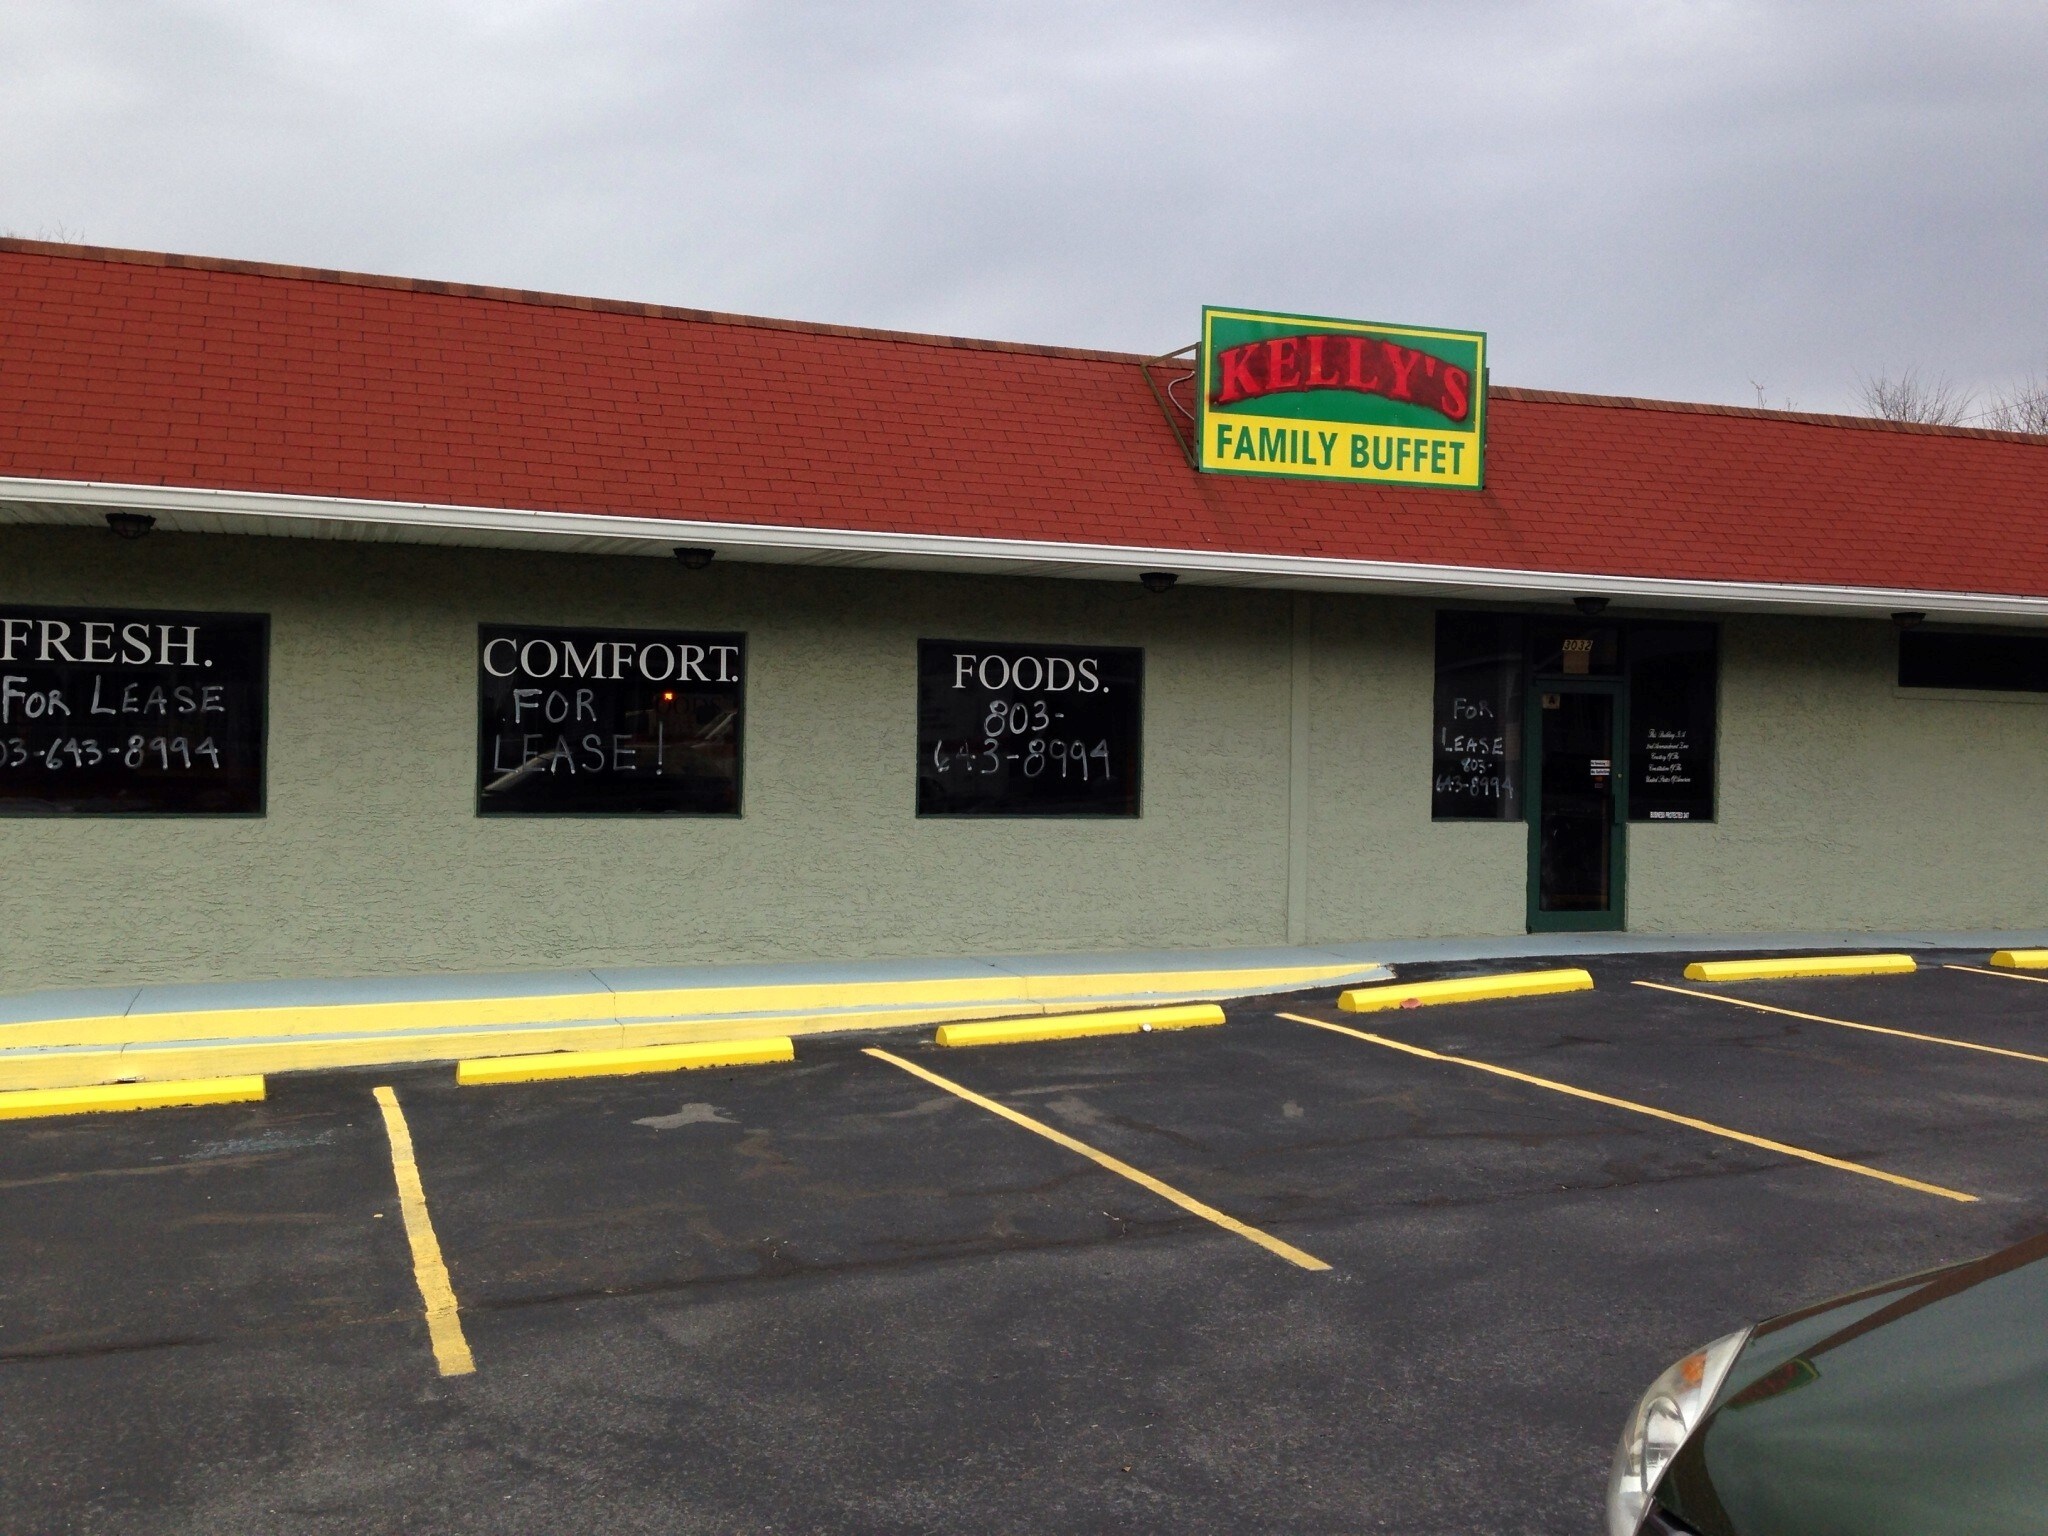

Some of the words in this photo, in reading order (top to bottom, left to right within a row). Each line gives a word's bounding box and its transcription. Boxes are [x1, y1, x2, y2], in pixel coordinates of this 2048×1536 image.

[1219, 335, 1468, 421] KELLY'S
[1217, 423, 1338, 466] FAMILY
[1351, 434, 1465, 475] BUFFET
[0, 618, 213, 667] FRESH.
[483, 638, 739, 682] COMFORT.
[1564, 640, 1591, 650] 3032
[952, 654, 1109, 693] FOODS.
[90, 674, 225, 715] LEASE
[514, 689, 597, 723] FOR
[984, 700, 1064, 737] 803-
[933, 738, 1110, 781] 643-8994
[1442, 727, 1503, 755] LEASE
[1461, 758, 1492, 774] 803-
[1436, 775, 1513, 799] 643-8994
